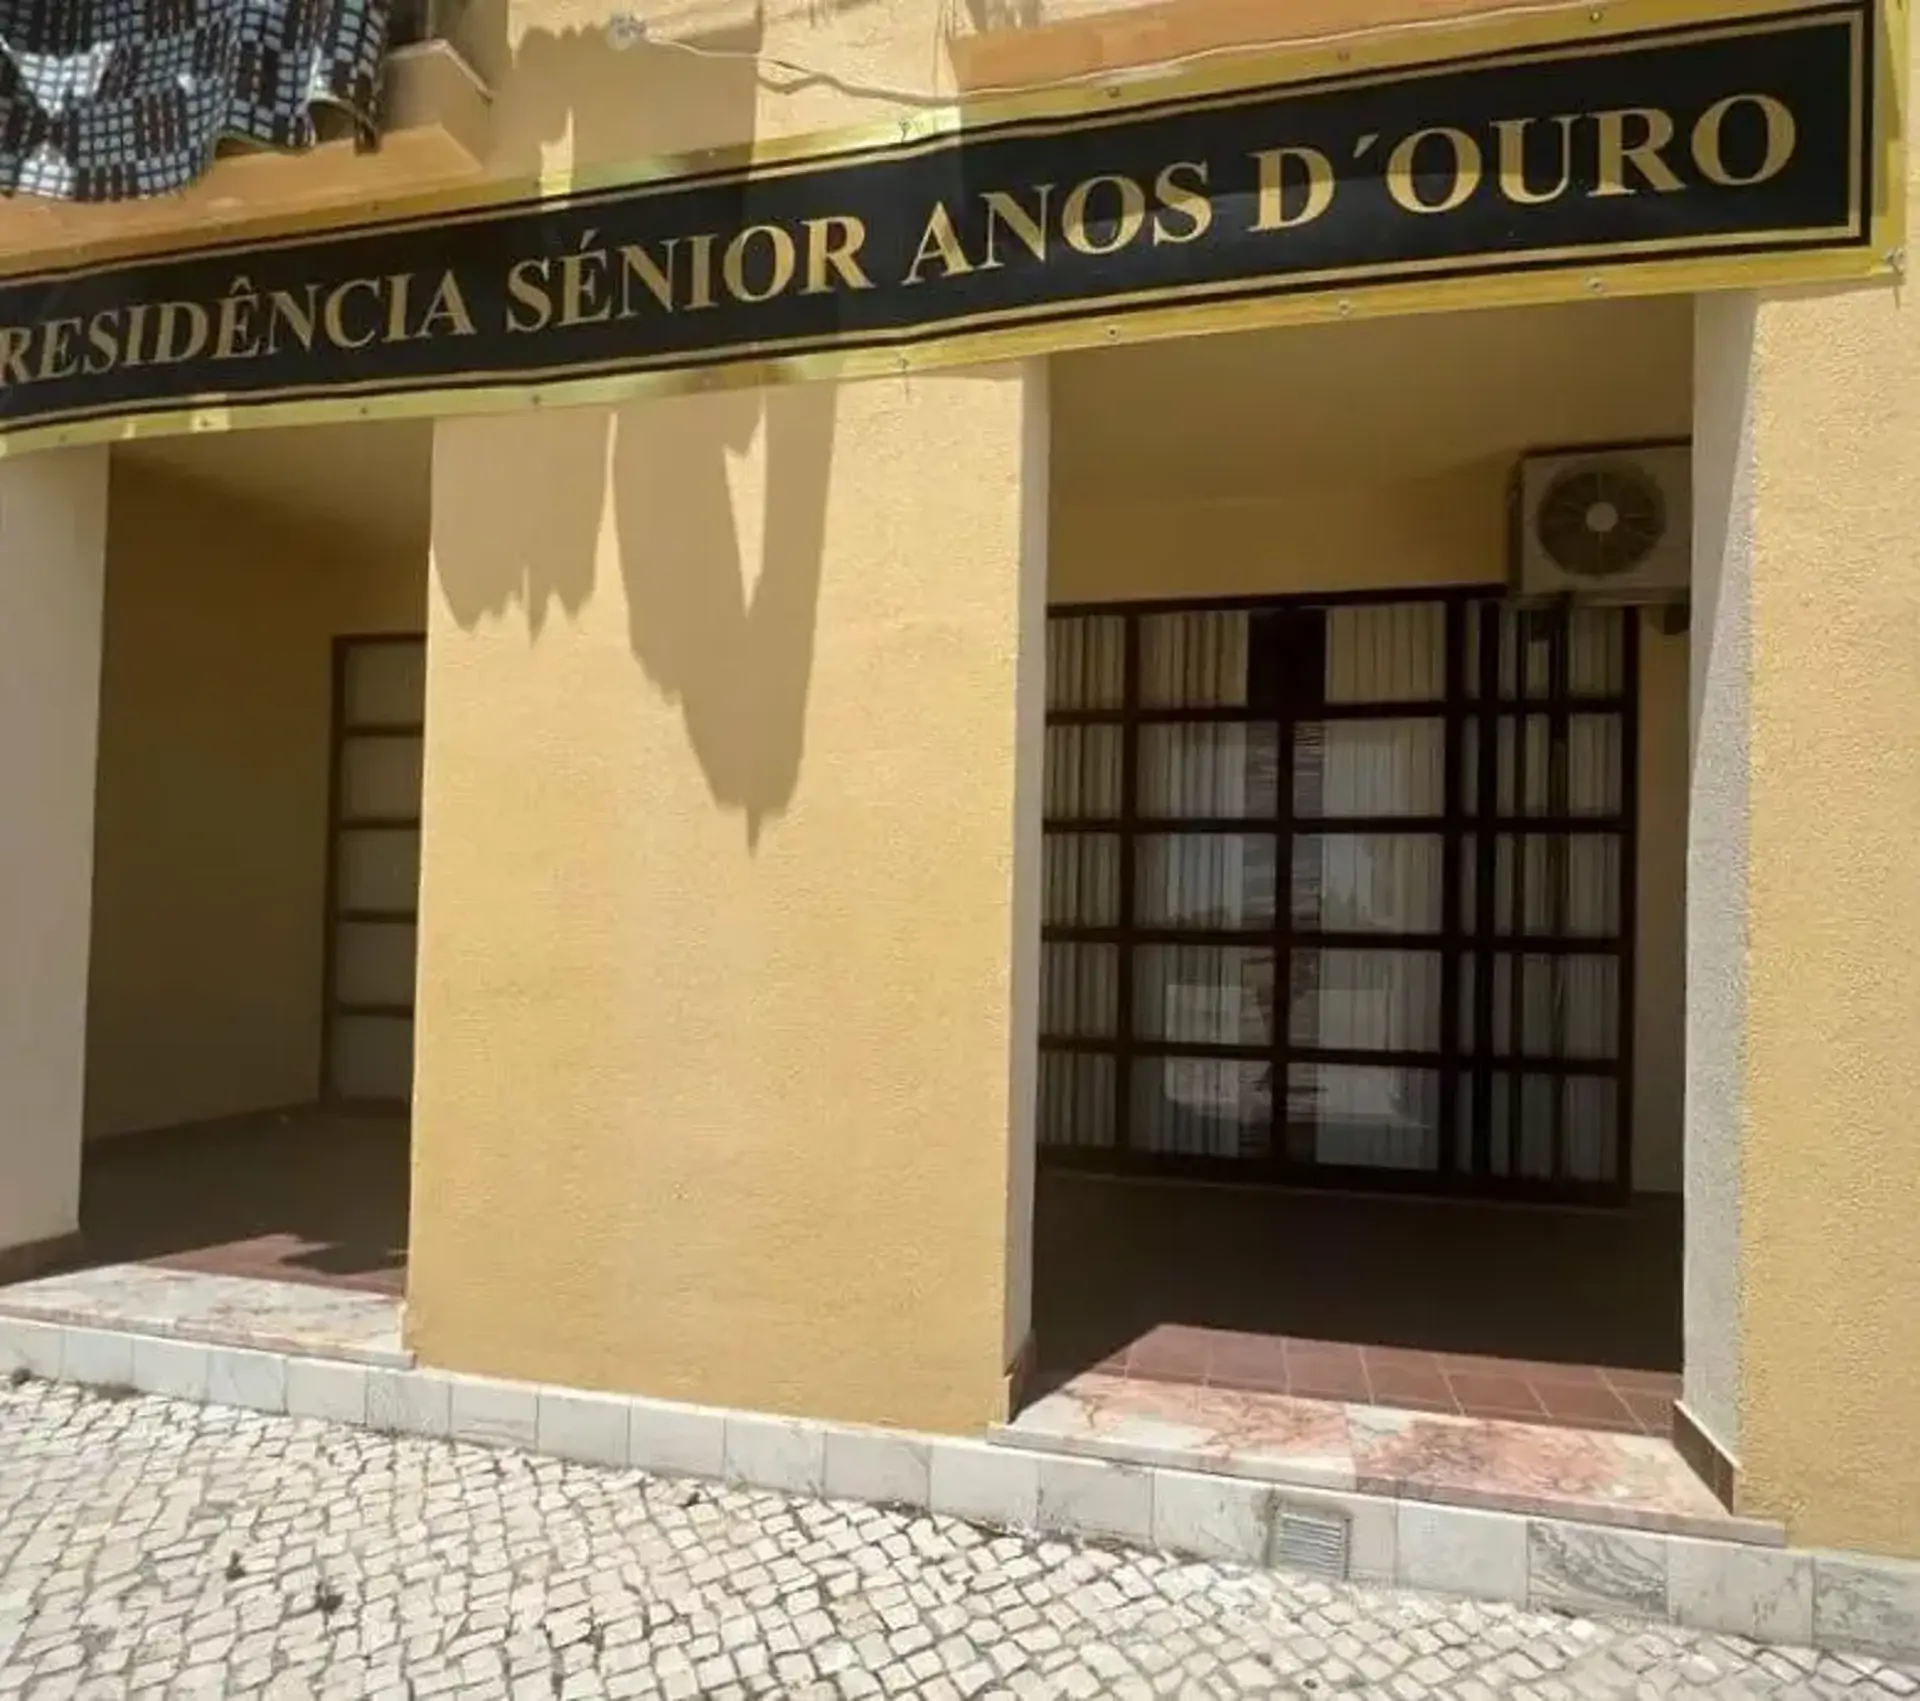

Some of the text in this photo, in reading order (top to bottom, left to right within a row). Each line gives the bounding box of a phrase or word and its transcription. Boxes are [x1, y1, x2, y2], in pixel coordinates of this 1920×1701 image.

[0, 269, 477, 387] RESIDÊNCIA
[506, 215, 876, 333] SÉNIOR
[902, 161, 1213, 286] ANOS
